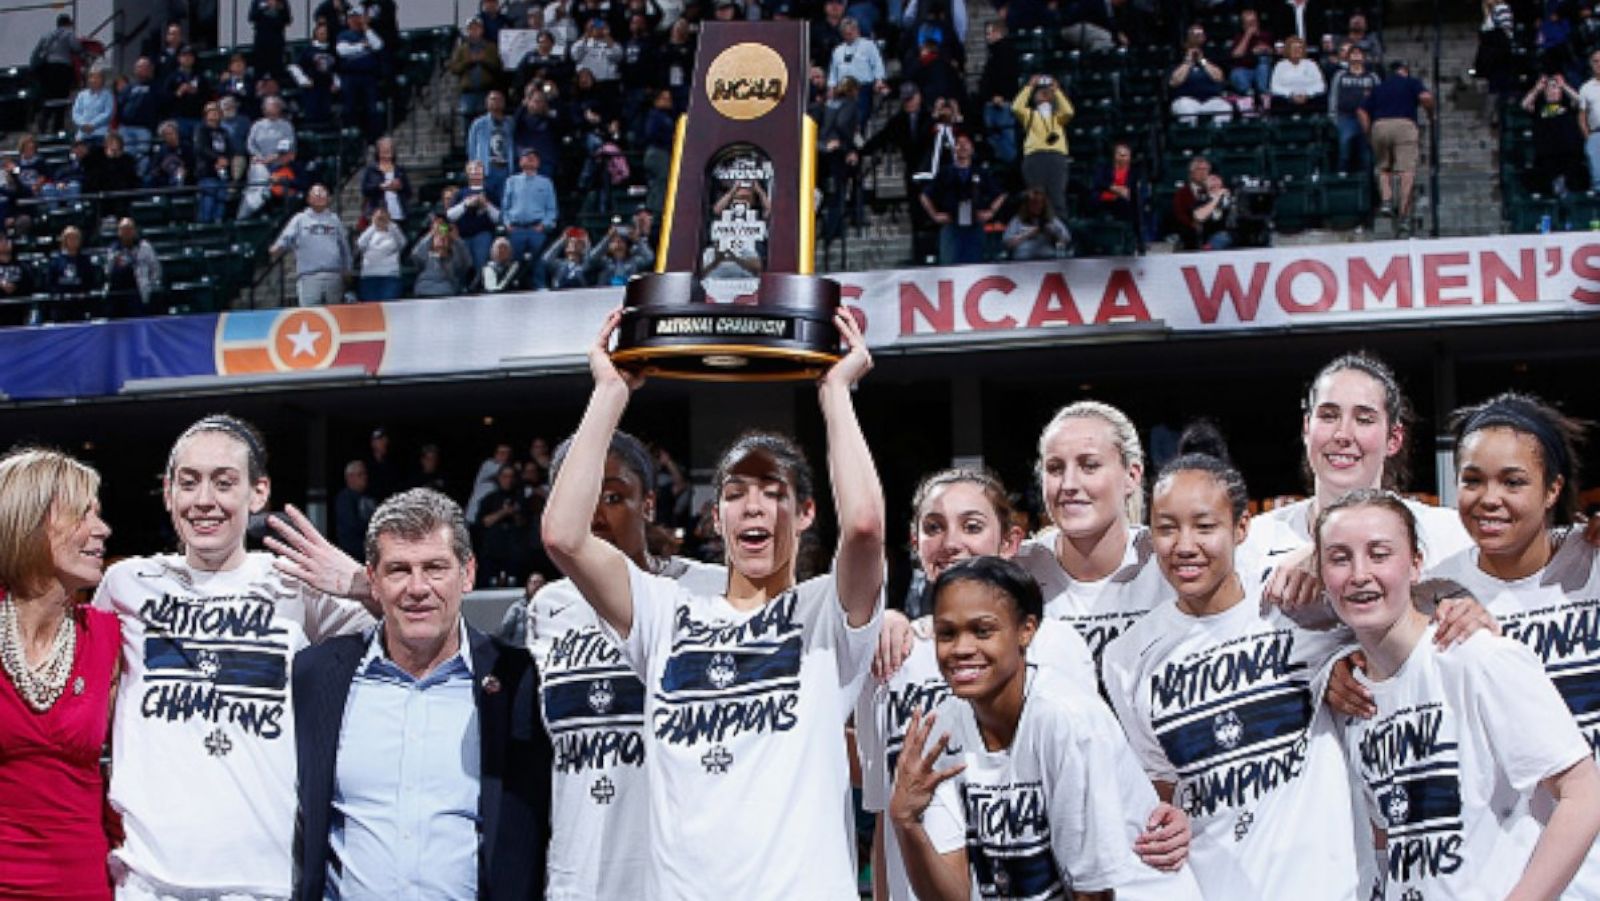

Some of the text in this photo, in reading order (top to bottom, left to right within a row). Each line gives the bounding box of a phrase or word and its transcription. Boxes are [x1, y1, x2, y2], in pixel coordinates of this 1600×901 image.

[712, 78, 782, 100] NCAA
[898, 269, 1154, 336] NCAA
[1180, 243, 1600, 324] WOMEN'S
[139, 593, 289, 637] NATIONAL
[1151, 630, 1308, 719] NATIONAL
